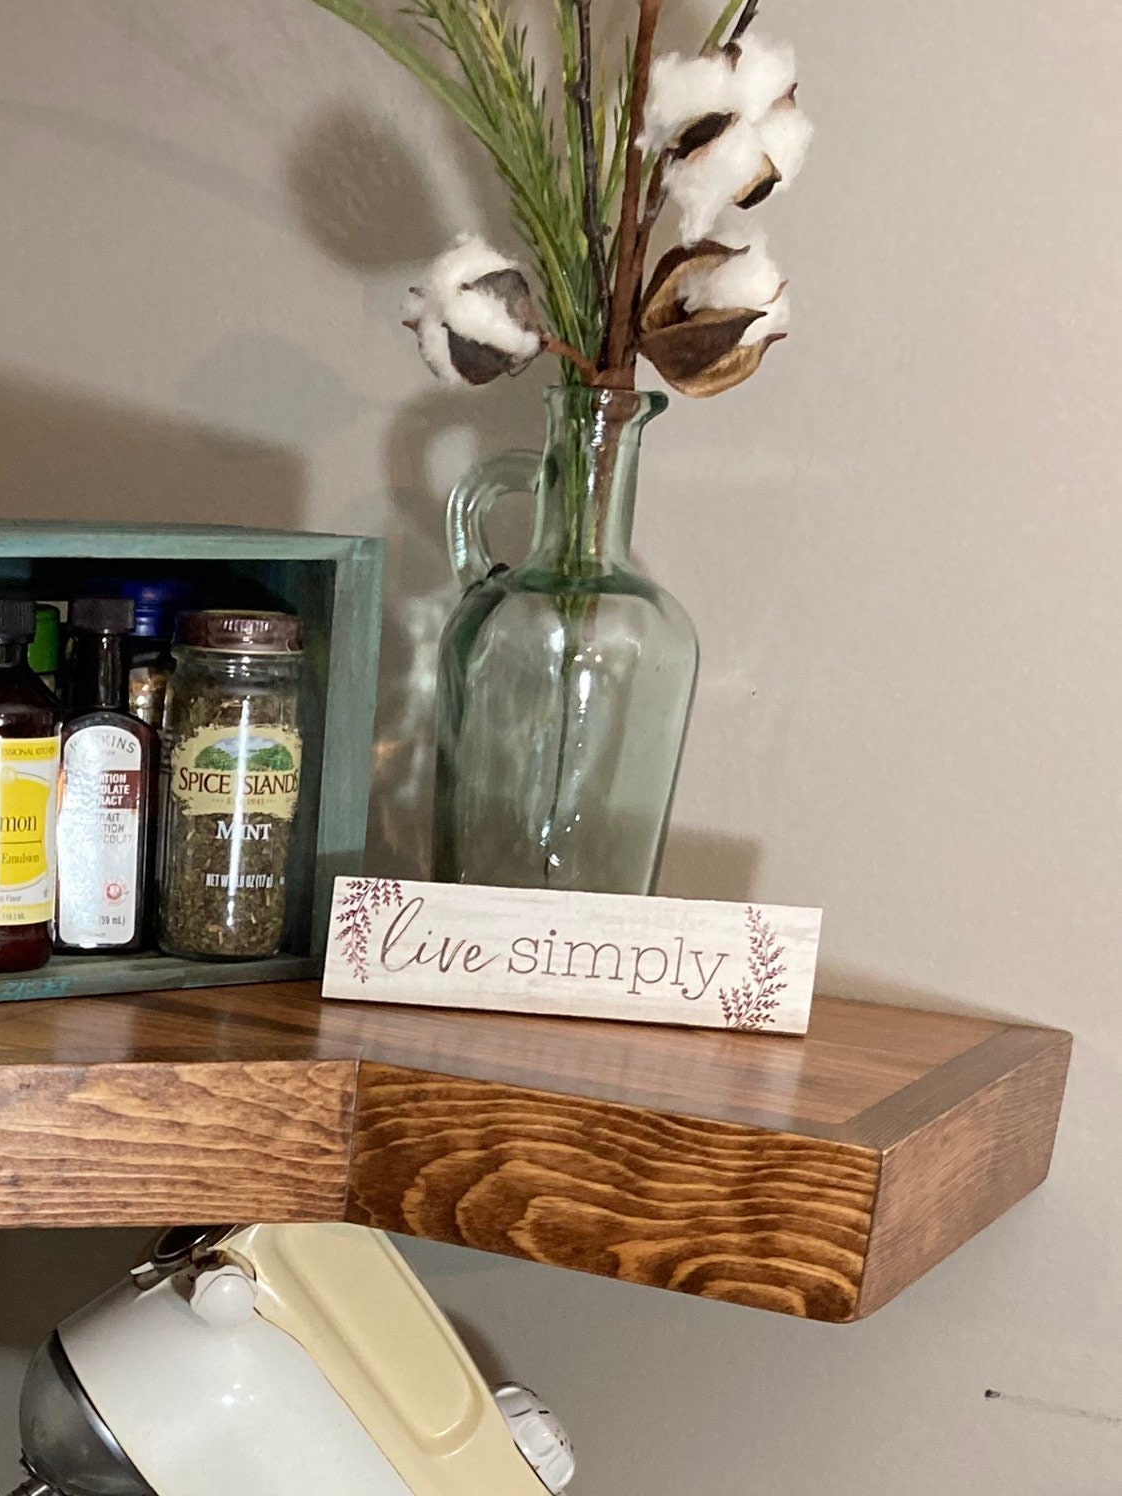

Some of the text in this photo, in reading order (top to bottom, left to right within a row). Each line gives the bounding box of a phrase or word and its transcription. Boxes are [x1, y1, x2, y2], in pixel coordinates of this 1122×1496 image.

[178, 767, 231, 794] SPICE
[379, 896, 729, 1001] live simply
